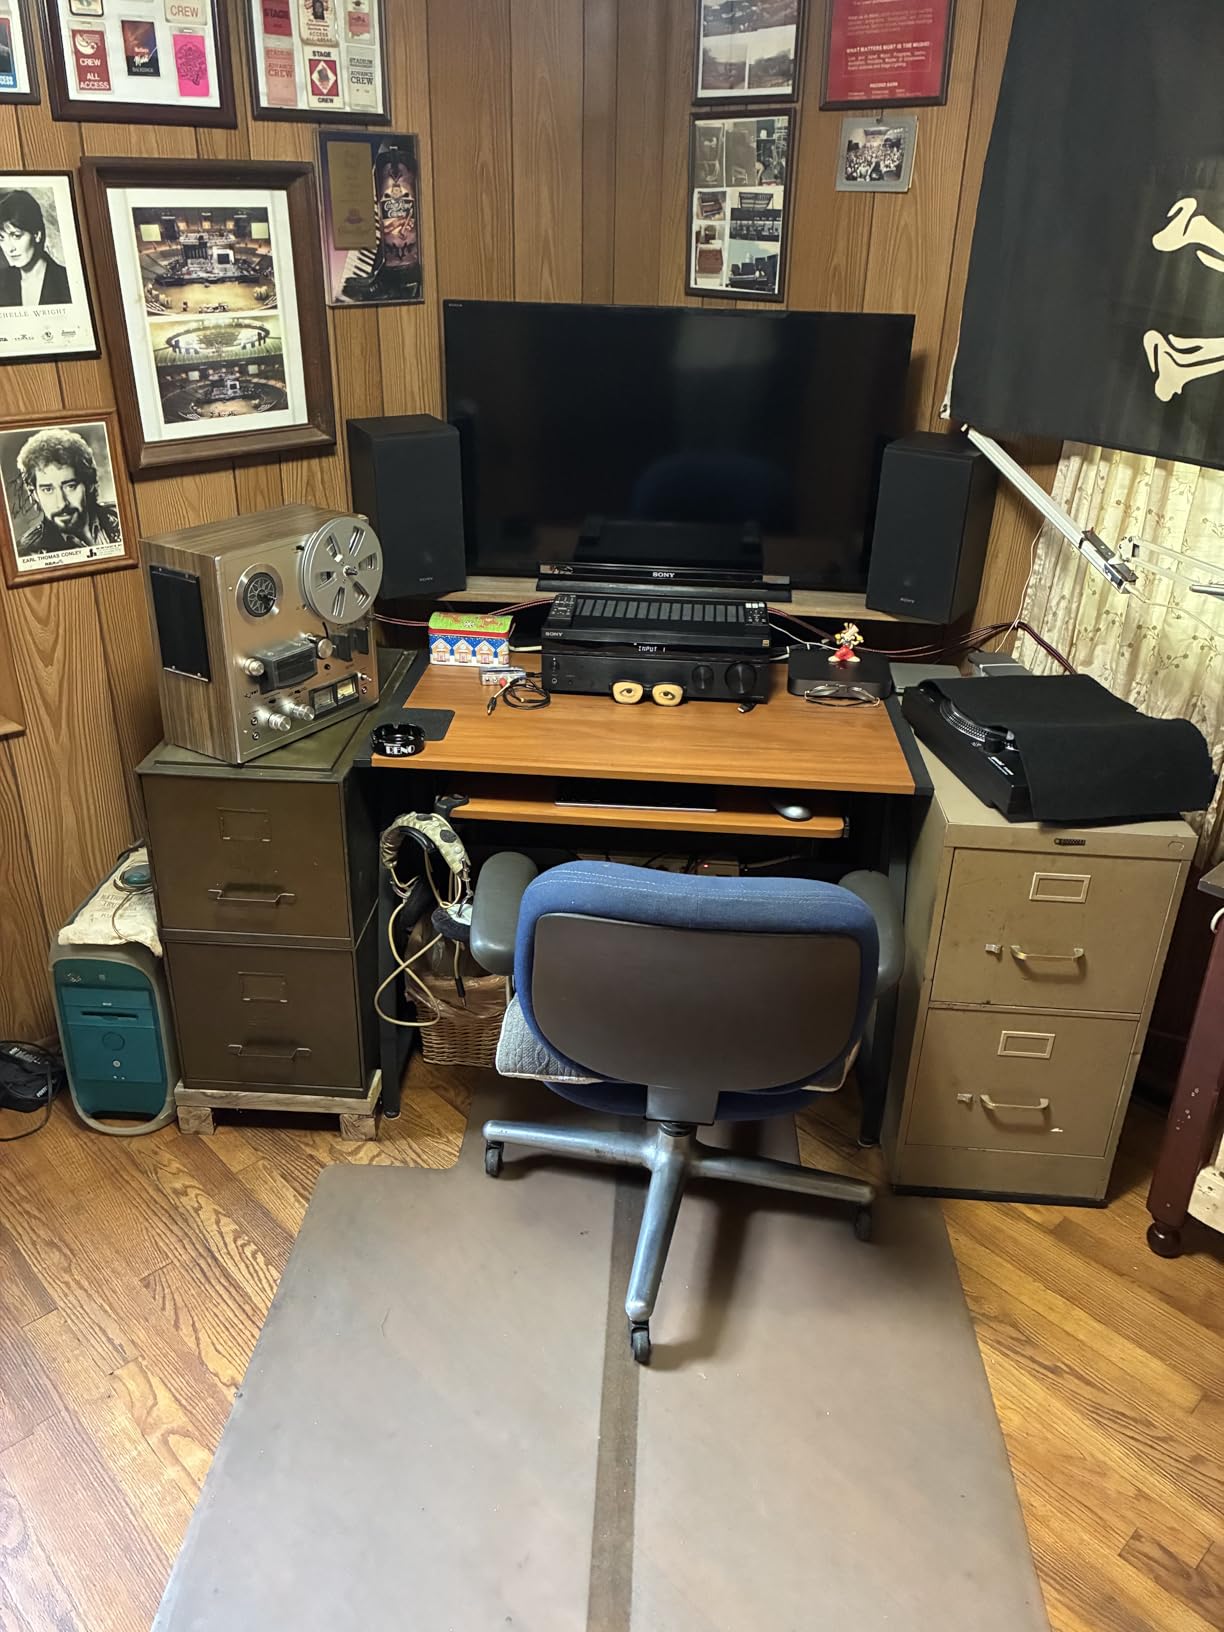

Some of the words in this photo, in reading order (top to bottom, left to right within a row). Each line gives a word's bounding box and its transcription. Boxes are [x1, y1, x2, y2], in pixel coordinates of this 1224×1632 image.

[170, 5, 199, 17] CREW
[267, 69, 293, 78] CREW
[80, 81, 110, 89] ACCESS
[350, 76, 374, 85] CREW
[33, 308, 67, 317] WRIGHT
[61, 550, 82, 558] CONLEY
[386, 744, 416, 755] RENO
